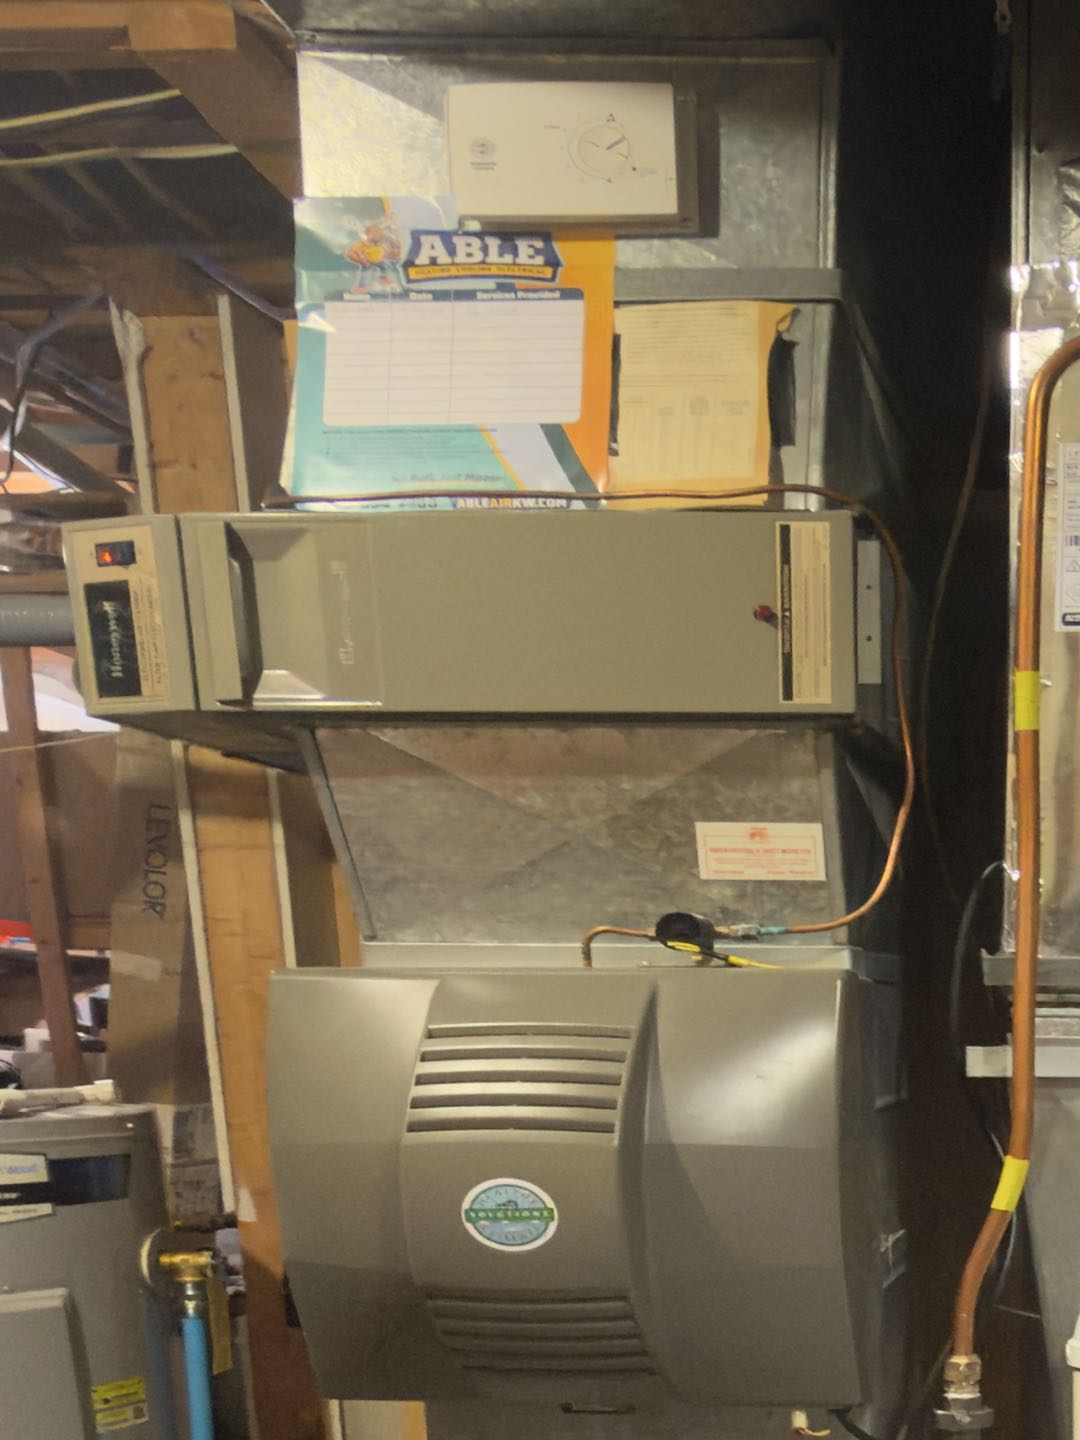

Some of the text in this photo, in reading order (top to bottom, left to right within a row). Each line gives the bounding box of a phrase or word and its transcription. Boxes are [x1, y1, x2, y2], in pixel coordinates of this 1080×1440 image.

[414, 234, 546, 265] ABLE
[101, 599, 124, 679] Honeywell
[142, 803, 171, 920] LEVOLOR
